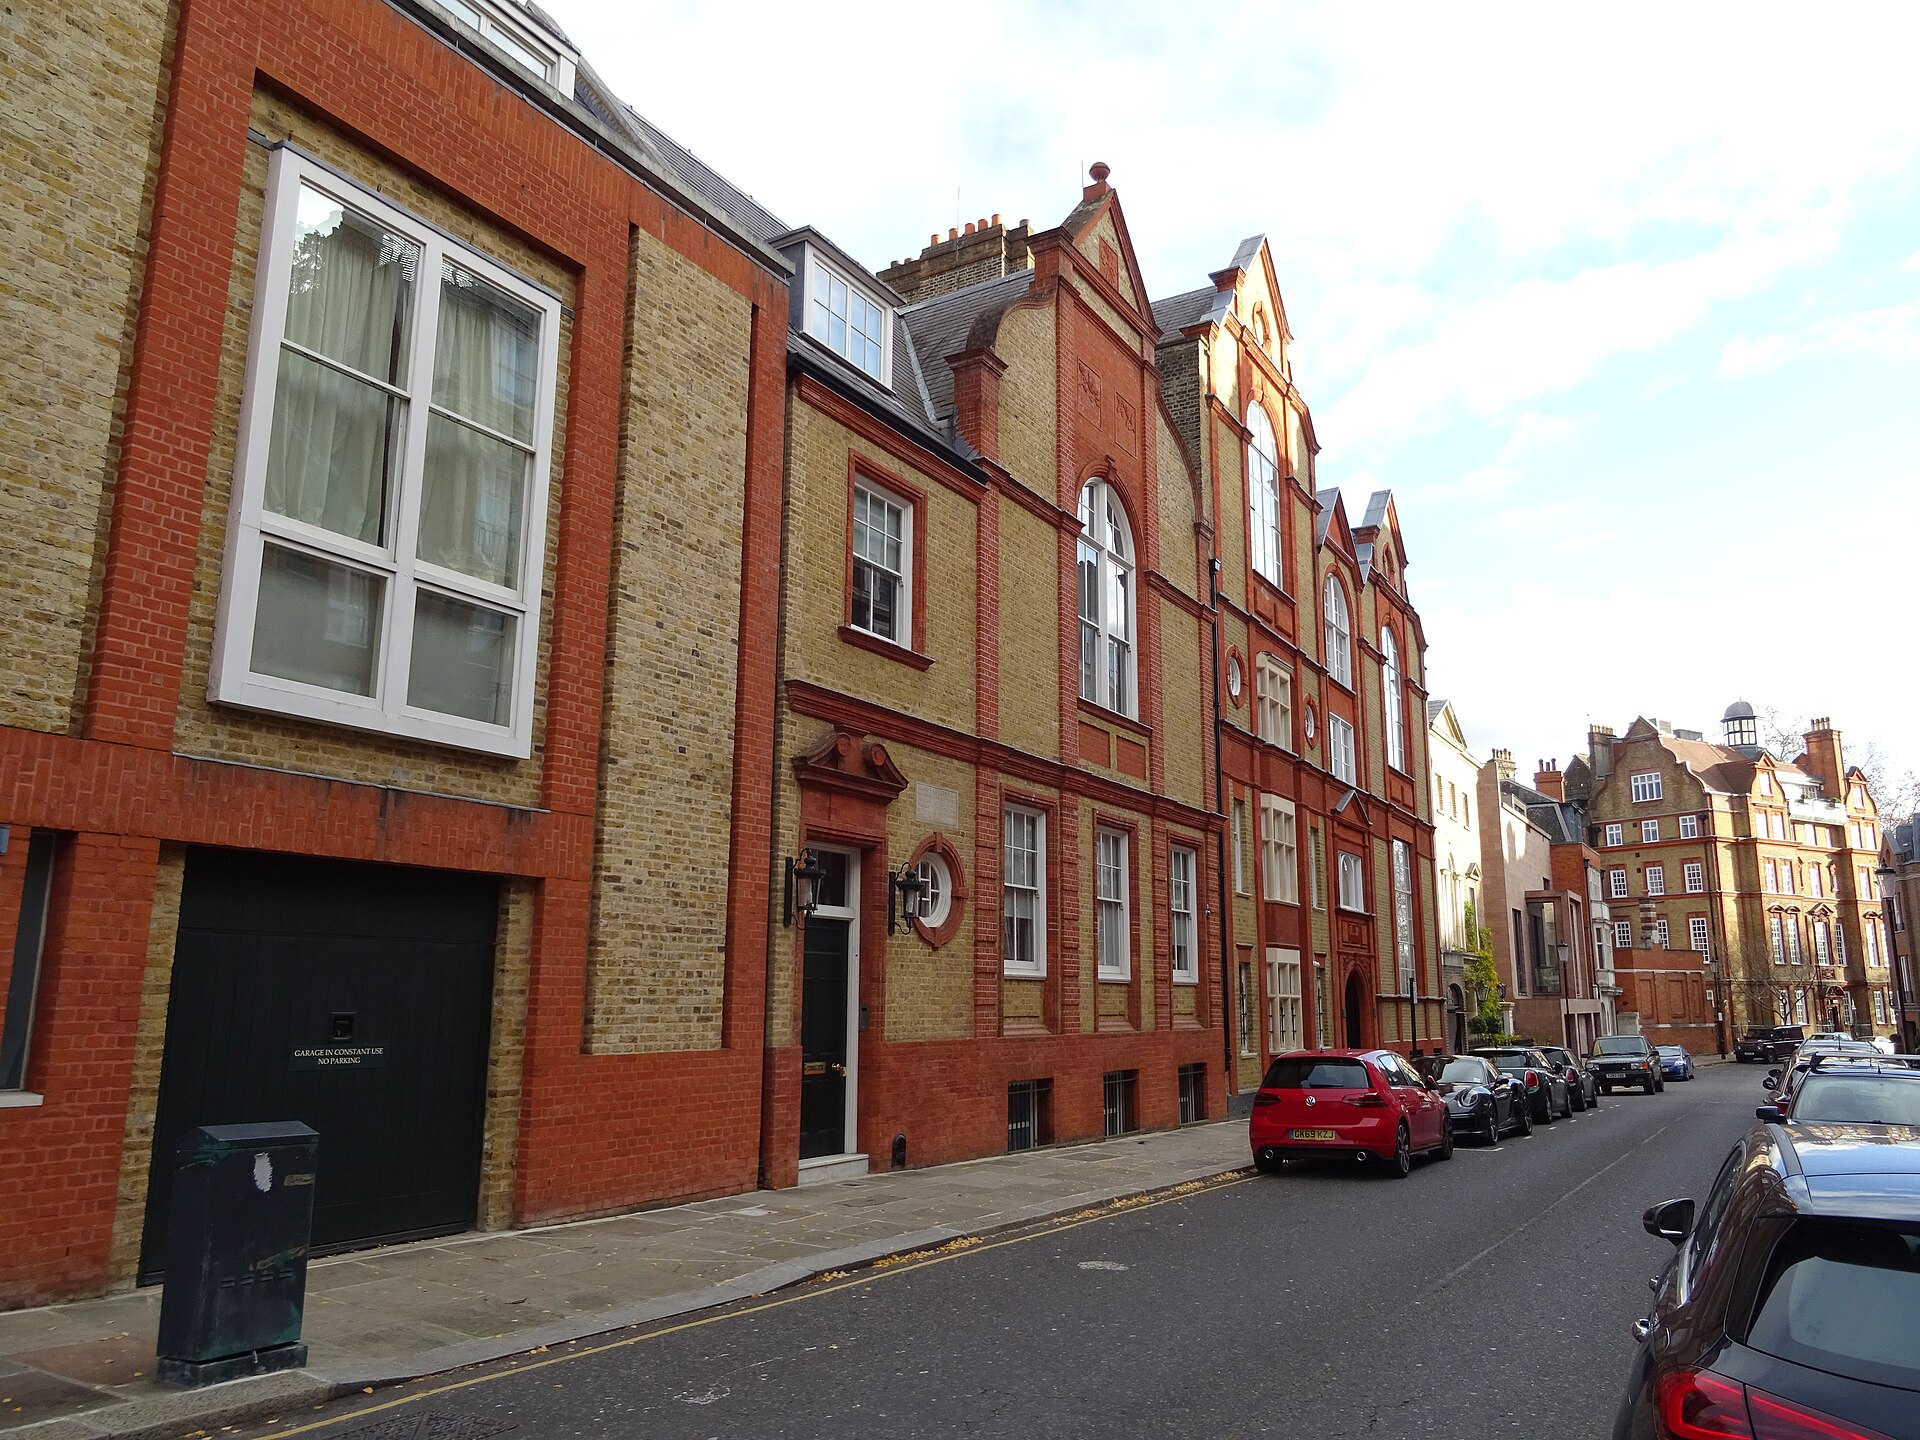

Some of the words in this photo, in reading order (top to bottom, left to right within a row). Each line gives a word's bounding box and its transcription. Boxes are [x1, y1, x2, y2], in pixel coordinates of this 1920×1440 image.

[294, 1049, 324, 1057] GARAGE
[325, 1048, 333, 1056] IN
[371, 1047, 384, 1055] USE
[1294, 1130, 1316, 1138] GK69
[1317, 1130, 1334, 1139] KZJ
